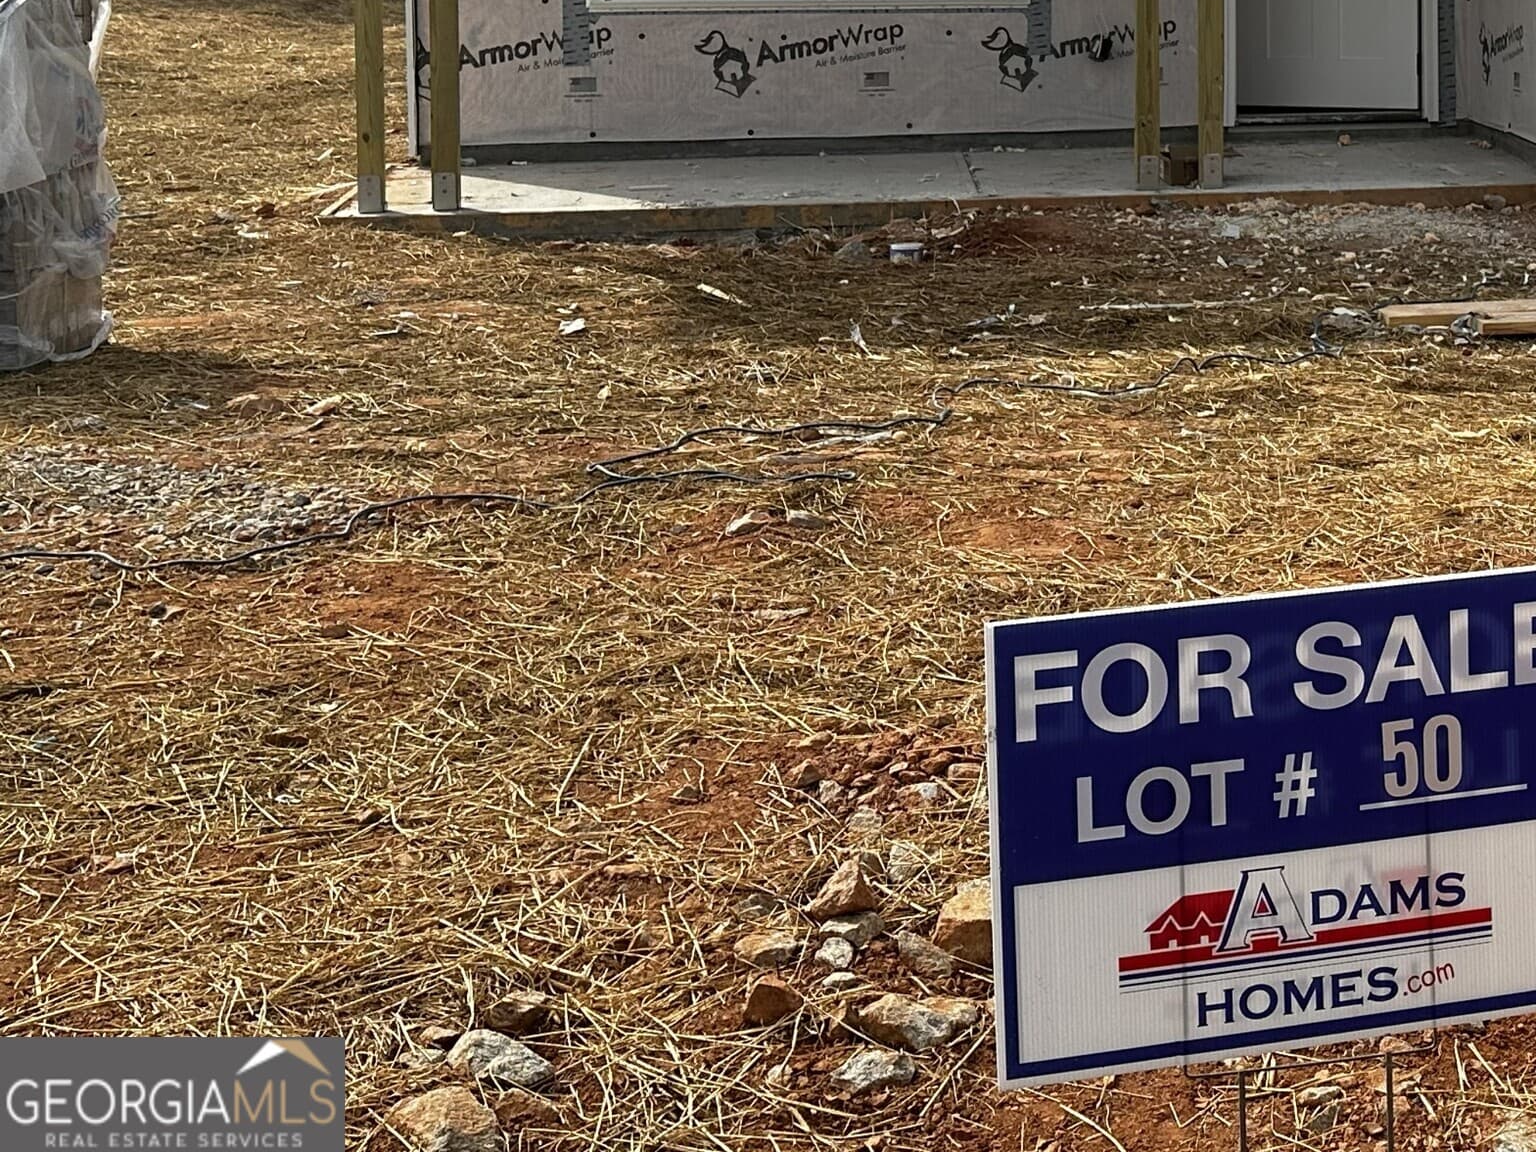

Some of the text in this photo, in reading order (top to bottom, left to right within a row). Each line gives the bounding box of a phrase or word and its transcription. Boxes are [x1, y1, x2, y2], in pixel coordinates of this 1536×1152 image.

[756, 24, 904, 68] ArmorWrap
[1013, 632, 1253, 743] FOR
[1076, 713, 1464, 844] LOT # 50
[1216, 865, 1467, 953] ADAMS
